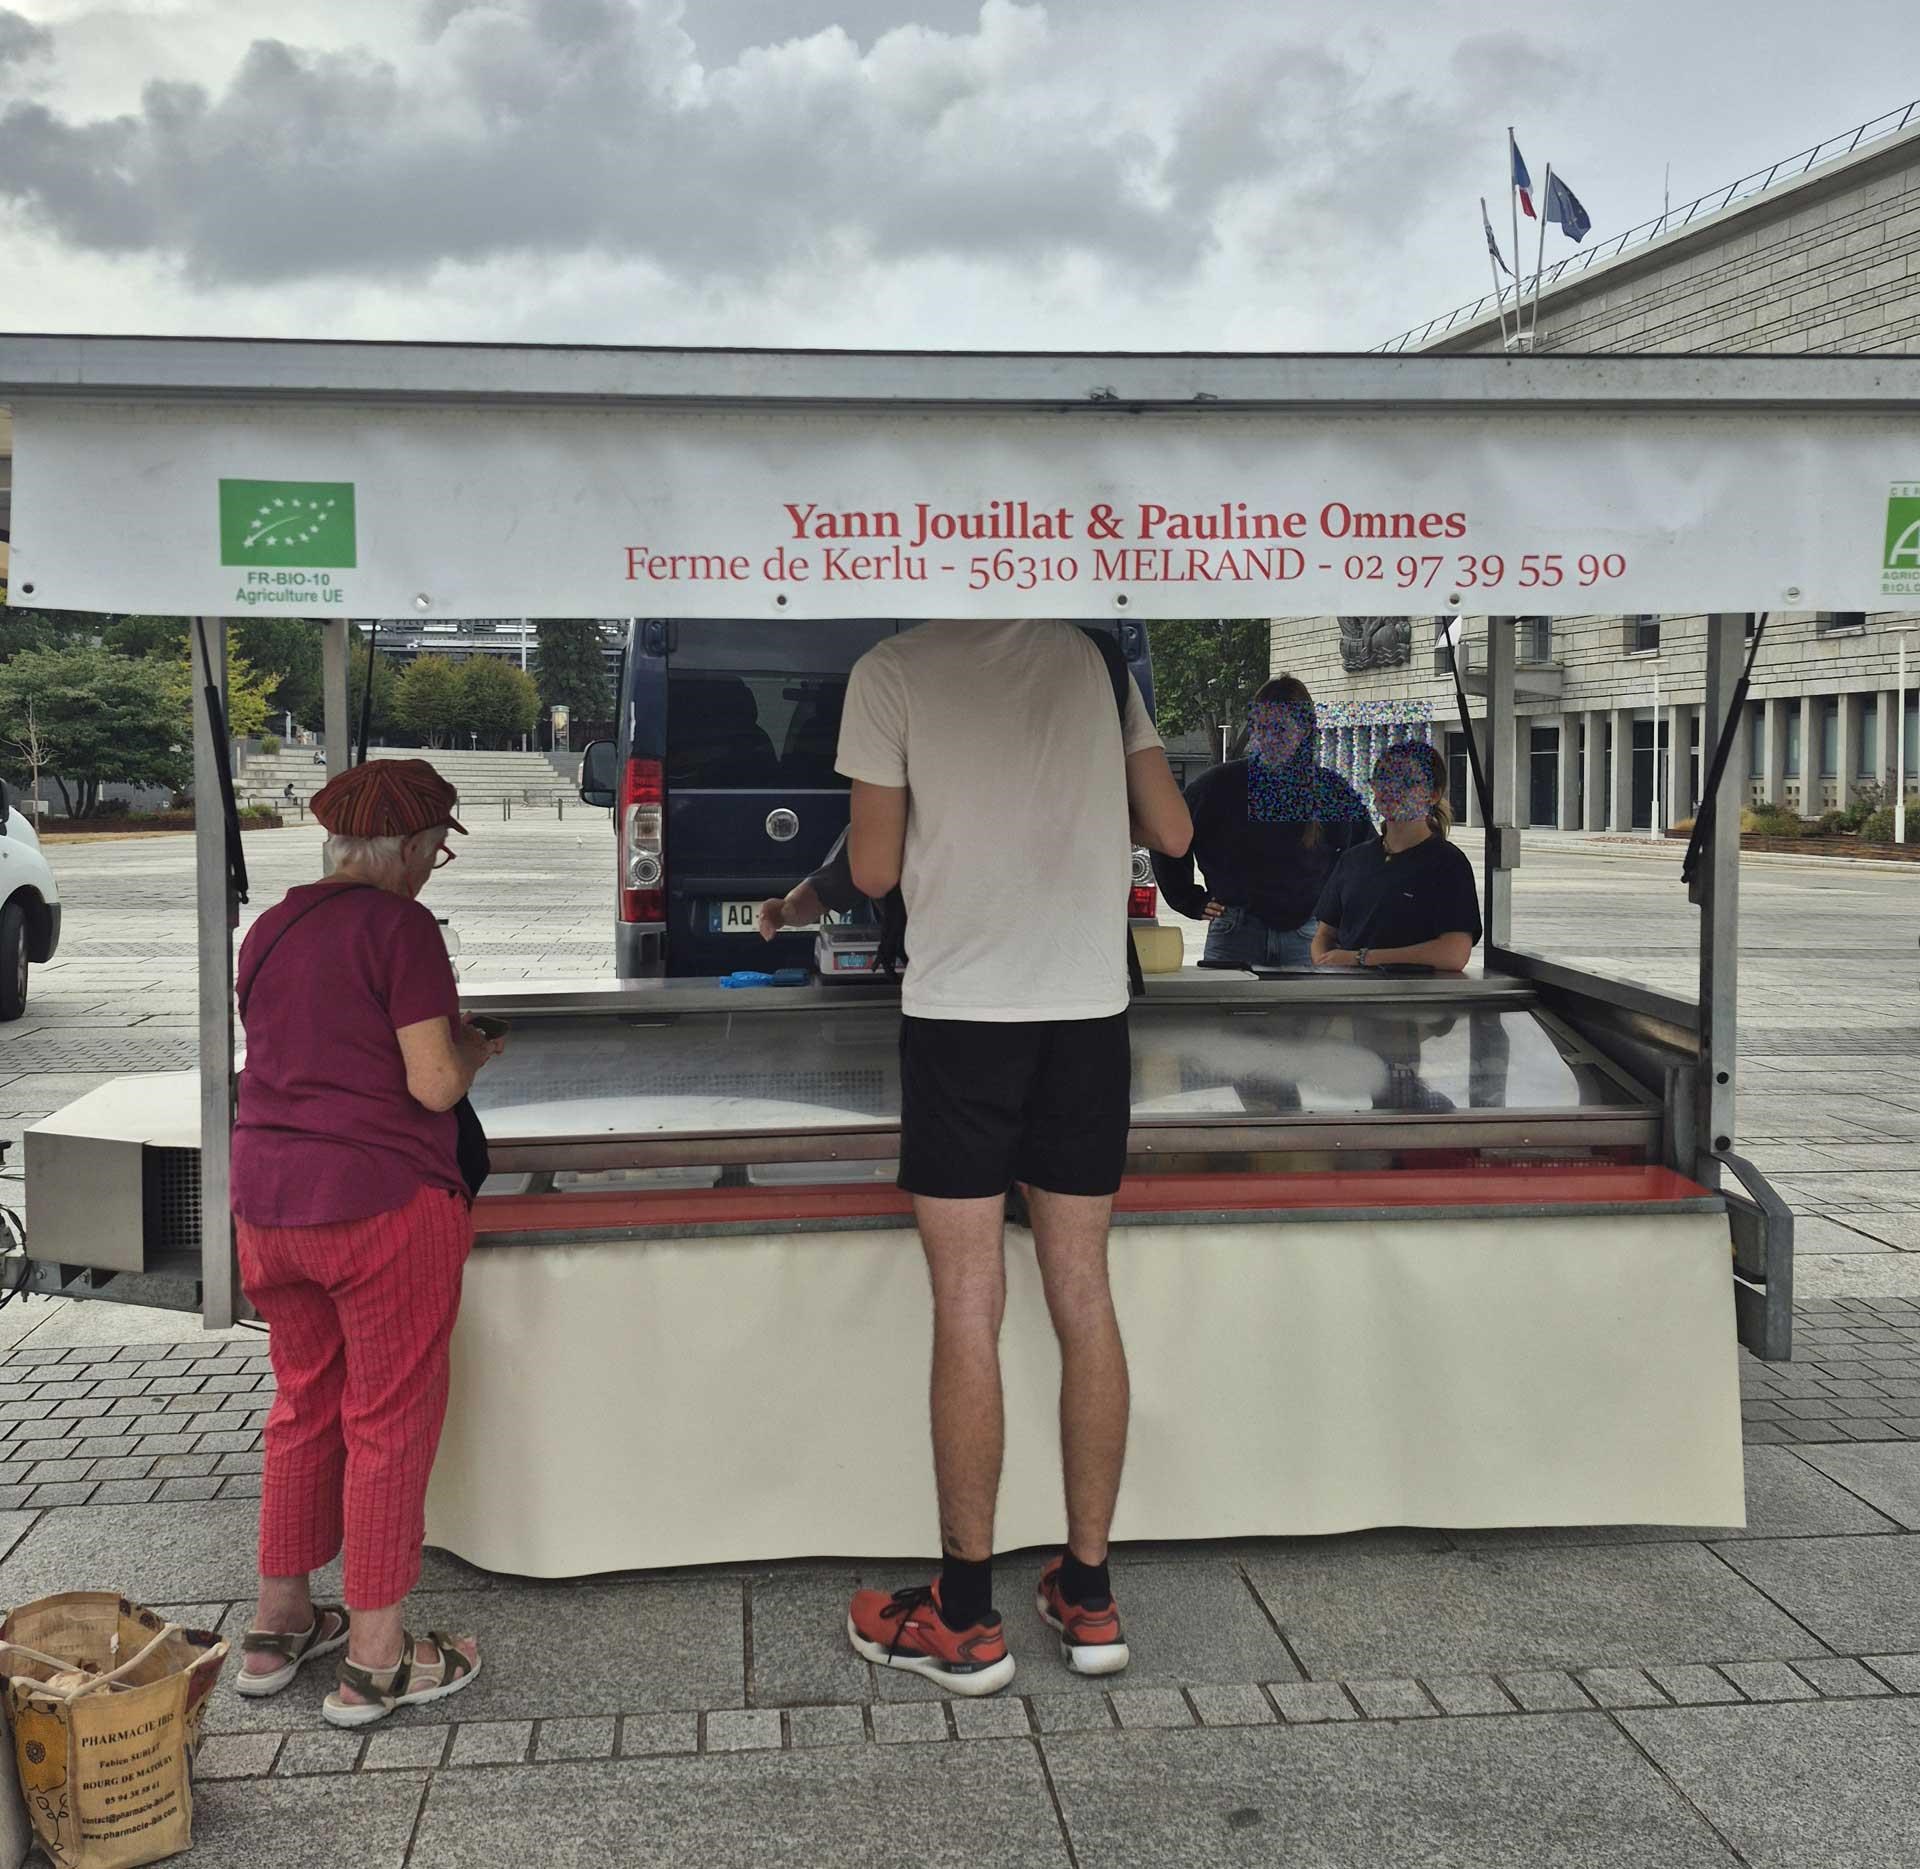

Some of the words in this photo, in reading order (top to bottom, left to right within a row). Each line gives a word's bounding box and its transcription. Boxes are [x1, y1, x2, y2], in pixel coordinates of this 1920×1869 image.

[784, 502, 901, 541] Yann
[909, 499, 1072, 547] Jouillat
[1084, 503, 1122, 541] &
[1139, 501, 1306, 541] Pauline
[1318, 502, 1467, 541] Omnes
[247, 572, 330, 586] FR-BIO-10
[625, 546, 750, 582] Ferme
[762, 544, 809, 582] de
[819, 544, 929, 582] Kerlu
[968, 547, 1079, 592] 56310
[1093, 546, 1306, 583] MELRAND
[1343, 555, 1383, 581] 02
[1394, 555, 1444, 589] 97
[1455, 554, 1505, 589] 39
[1519, 554, 1564, 589] 55
[1576, 554, 1627, 587] 90
[236, 587, 318, 605] Agriculture
[322, 589, 344, 603] UE
[81, 1720, 156, 1747] PHARMACIE
[83, 1778, 119, 1791] BOURG
[121, 1772, 136, 1784] DE
